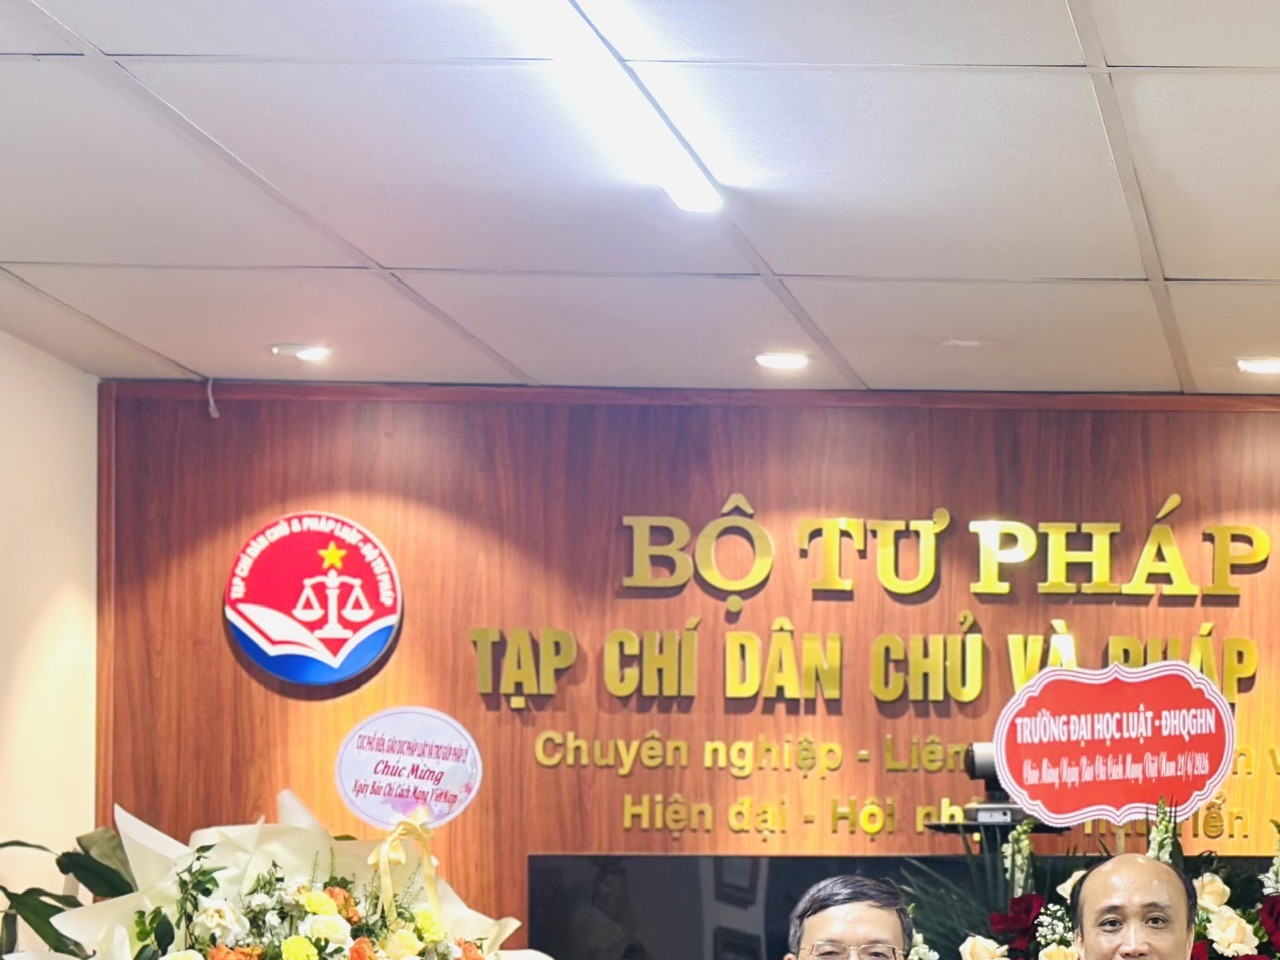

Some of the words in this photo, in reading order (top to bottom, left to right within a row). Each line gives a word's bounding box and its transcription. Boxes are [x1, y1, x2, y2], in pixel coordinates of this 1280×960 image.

[301, 516, 336, 534] PHÁP
[622, 493, 776, 614] BỘ
[798, 507, 951, 596] TƯ
[968, 493, 1271, 597] PHÁP
[470, 627, 578, 709] TẠP
[604, 616, 702, 698] CHÍ
[724, 616, 842, 700] DÂN
[868, 609, 985, 703] CHỦ
[1007, 619, 1077, 692] VÀ
[1015, 708, 1068, 744] TRƯỜNG
[1069, 713, 1092, 747] ĐẠI
[1094, 711, 1121, 746] HỌC
[1122, 703, 1153, 745] LUẬT
[1161, 707, 1216, 742] ĐHQGHN
[374, 758, 406, 777] Chúc
[407, 764, 444, 785] Mừng
[534, 729, 689, 776] Chuyên
[703, 732, 843, 779] nghiệp
[622, 793, 714, 838] Hiện
[727, 794, 787, 840] đại
[831, 795, 896, 840] Hội
[915, 797, 982, 842] nh
